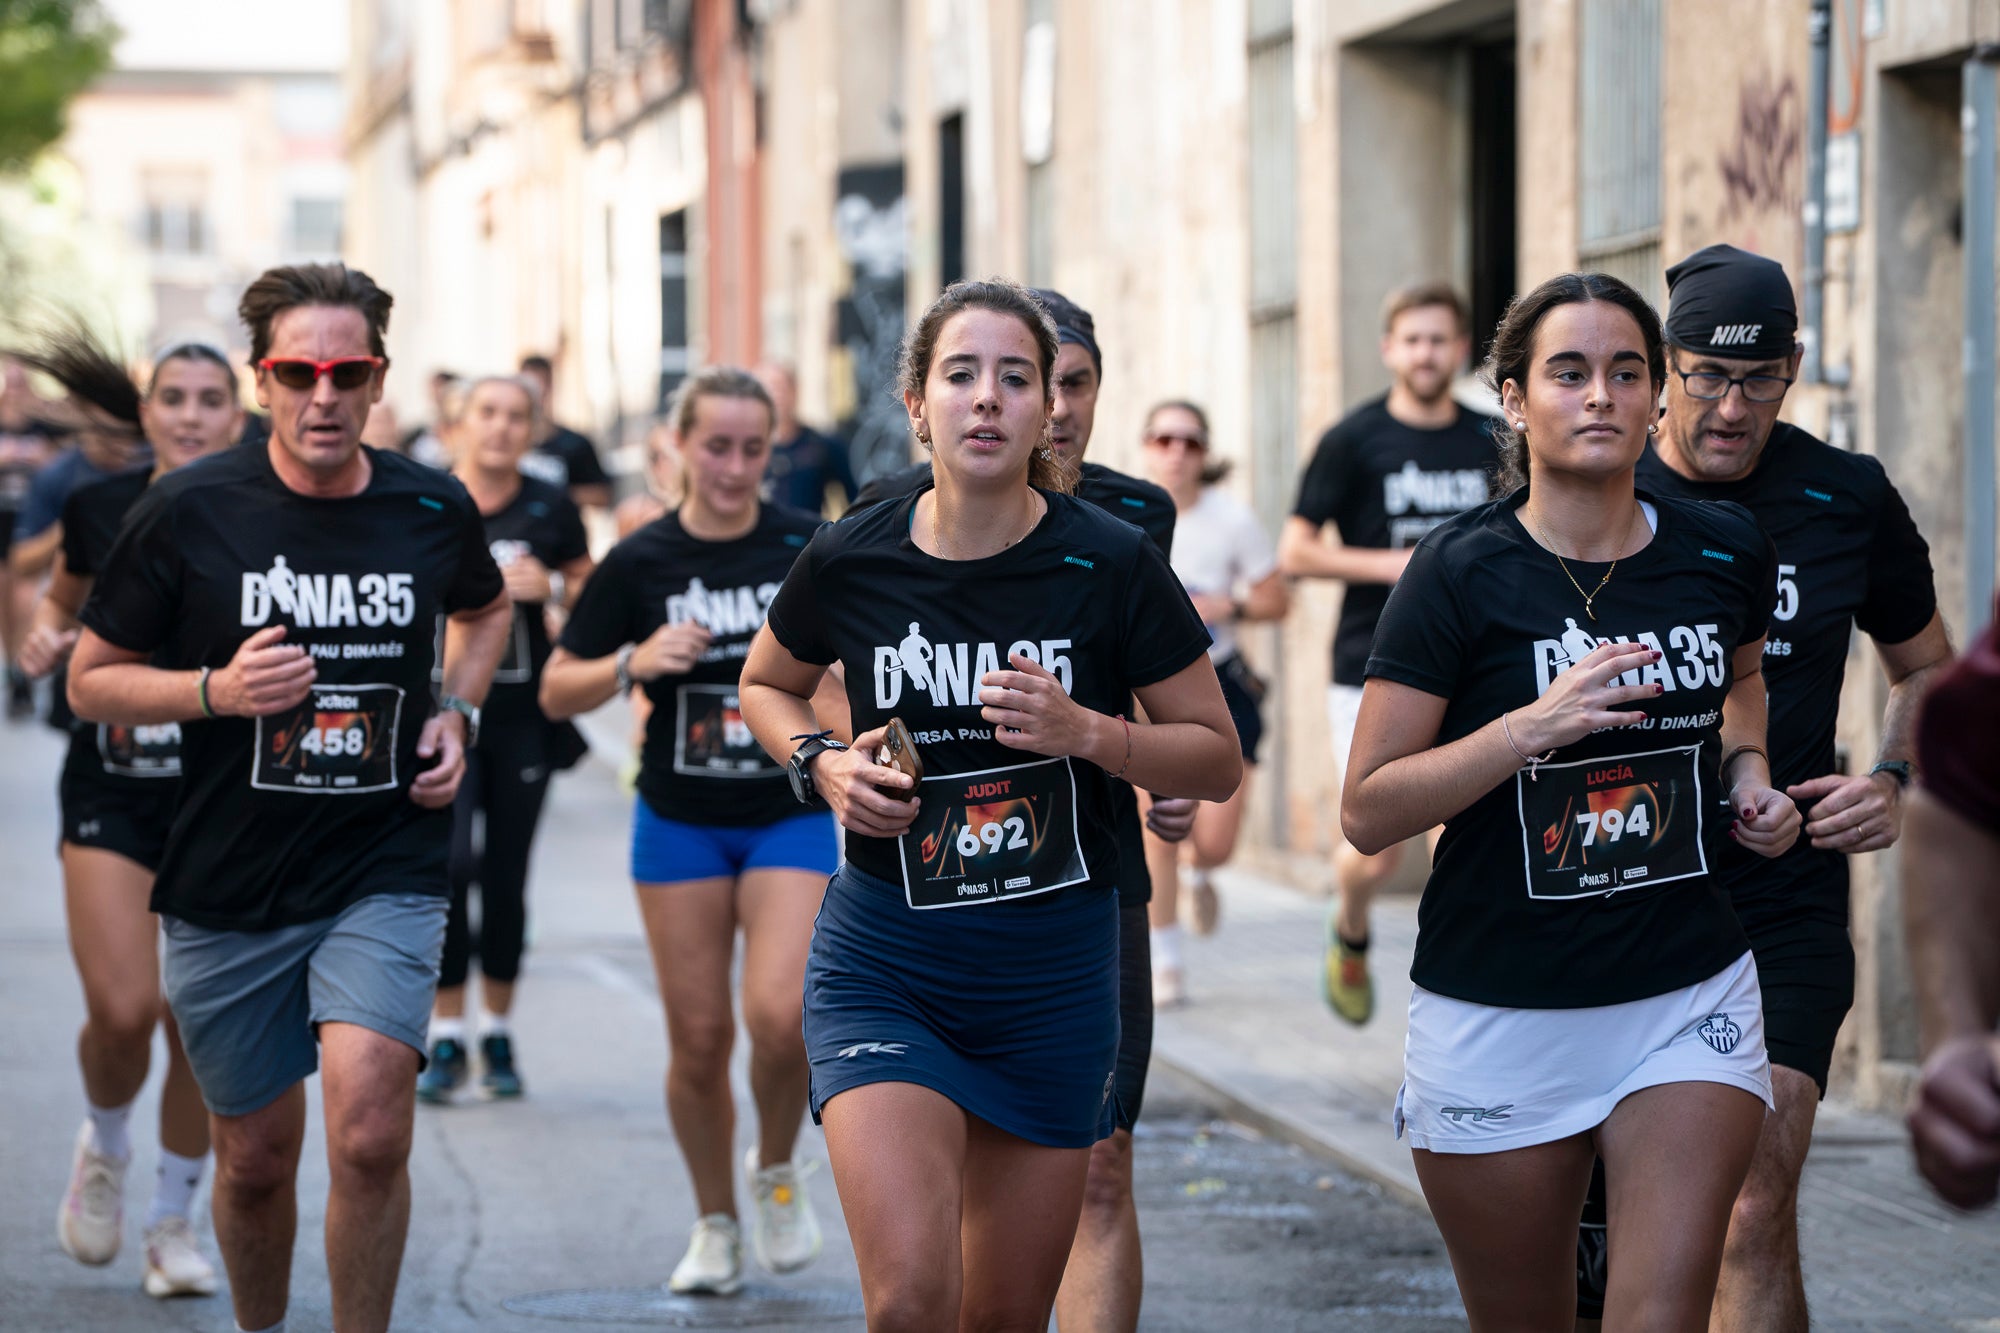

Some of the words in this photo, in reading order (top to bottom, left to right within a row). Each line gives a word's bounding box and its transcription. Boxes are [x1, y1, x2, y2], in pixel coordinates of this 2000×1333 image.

[1710, 324, 1762, 346] NIKE
[1064, 555, 1095, 570] RUNNEK
[1702, 548, 1734, 562] RUNNEK
[309, 643, 340, 659] PAU
[1620, 716, 1655, 731] AU
[1659, 710, 1719, 730] DINARÈS
[301, 727, 364, 756] 458
[909, 728, 954, 745] URSA
[958, 728, 991, 740] PAU
[1586, 764, 1634, 786] LUCÍA
[964, 780, 1012, 799] JUDIT
[1577, 803, 1650, 847] 794
[956, 816, 1029, 857] 692
